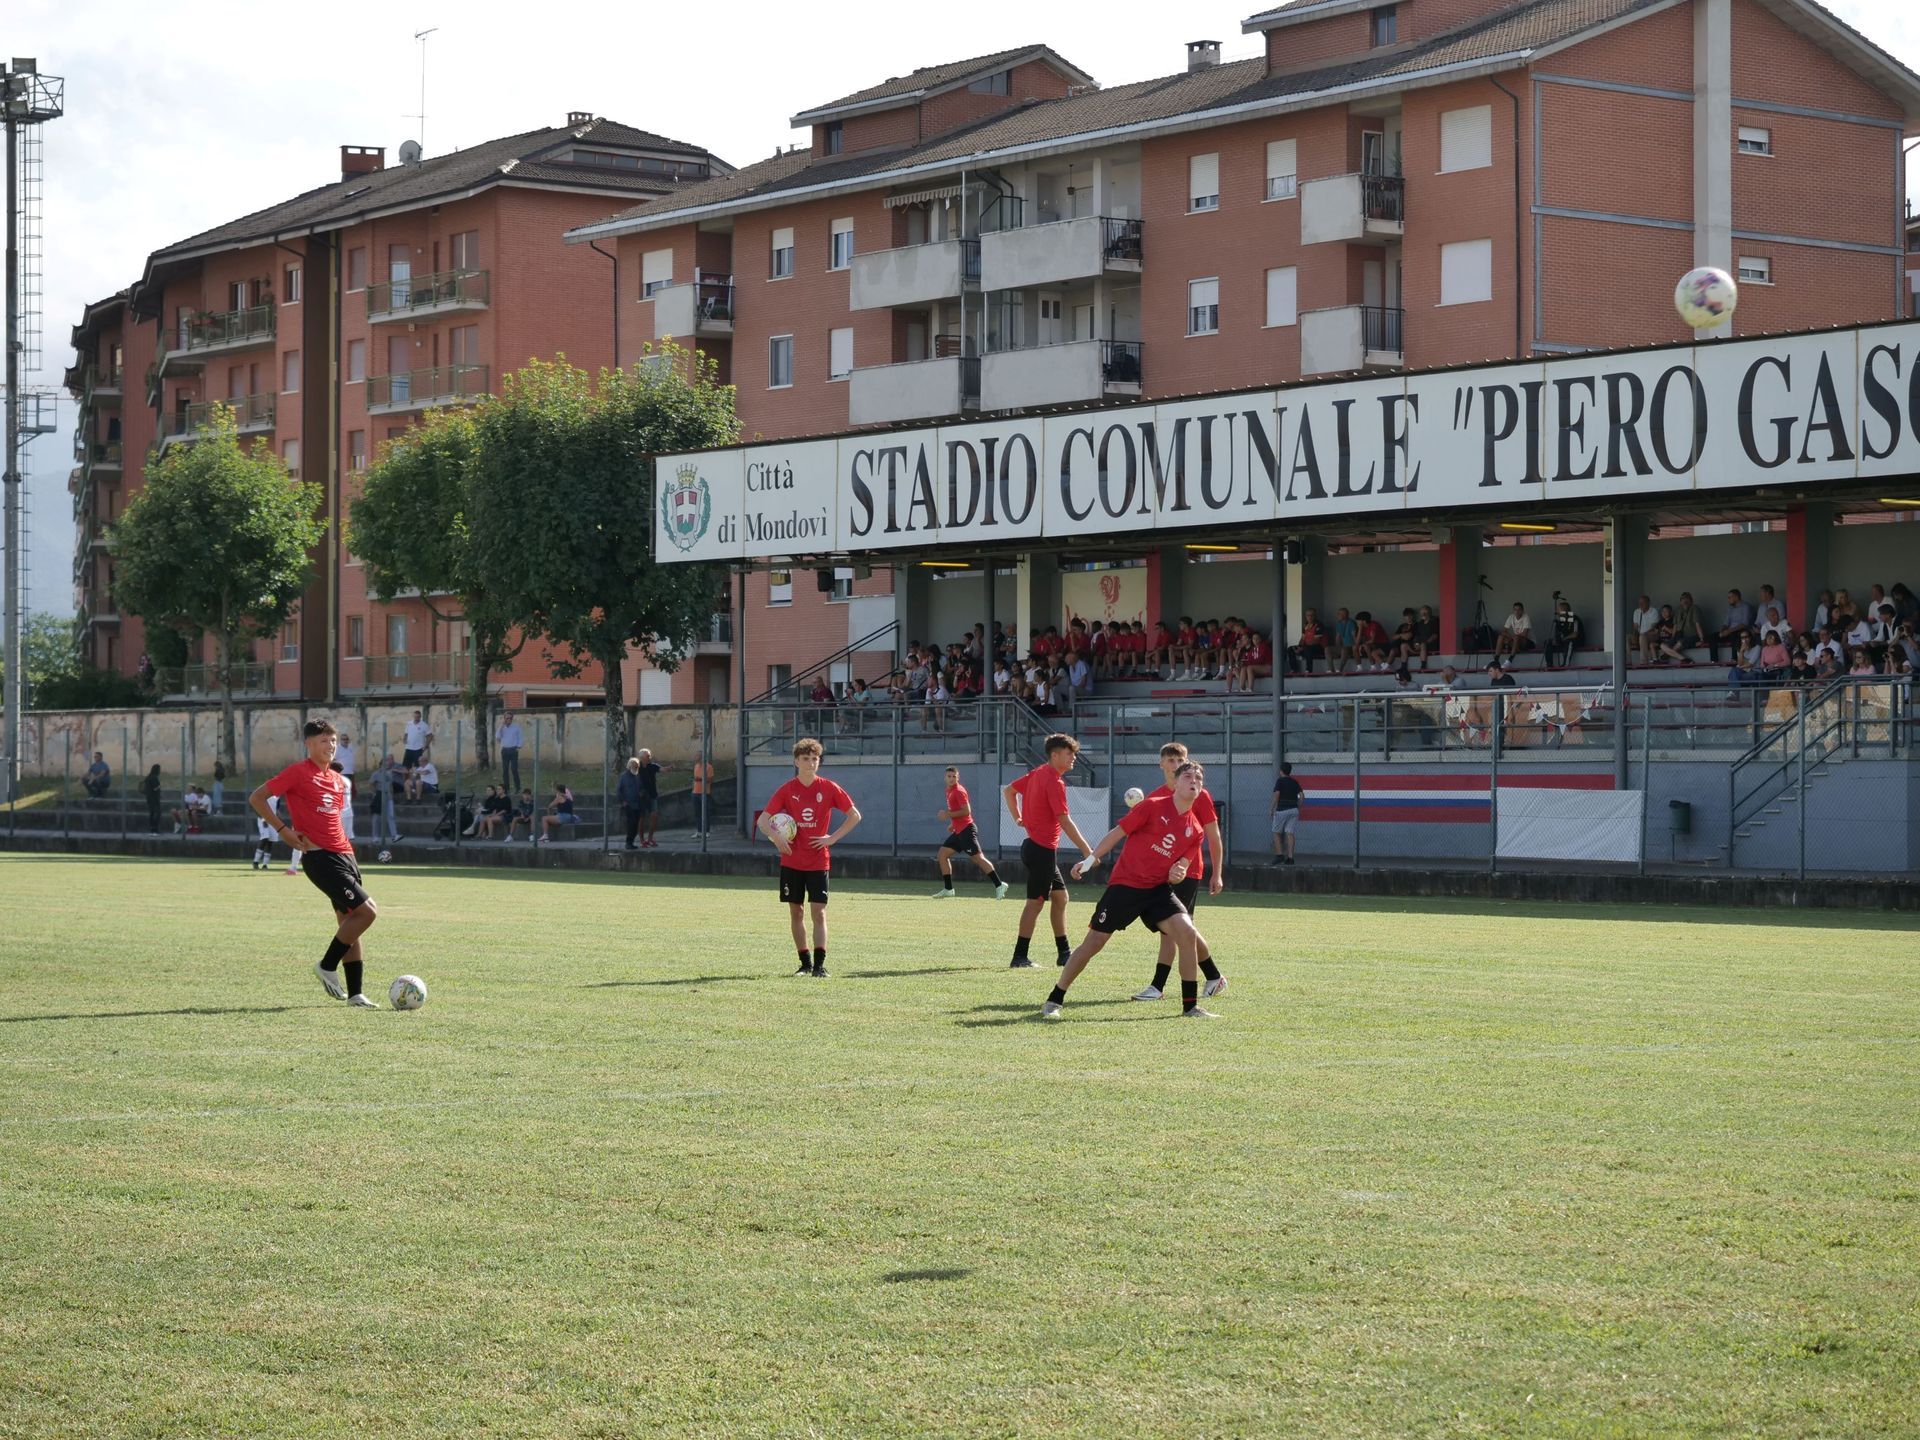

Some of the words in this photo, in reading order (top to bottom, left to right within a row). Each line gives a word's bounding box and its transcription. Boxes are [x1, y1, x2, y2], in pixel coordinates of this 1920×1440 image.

[850, 432, 1038, 537] STADIO
[1060, 393, 1421, 522] COMUNALE
[1453, 365, 1708, 488] "PIERO
[1737, 342, 1920, 469] GAS
[746, 459, 795, 492] Città
[717, 514, 736, 544] di
[744, 507, 828, 542] Mondovì
